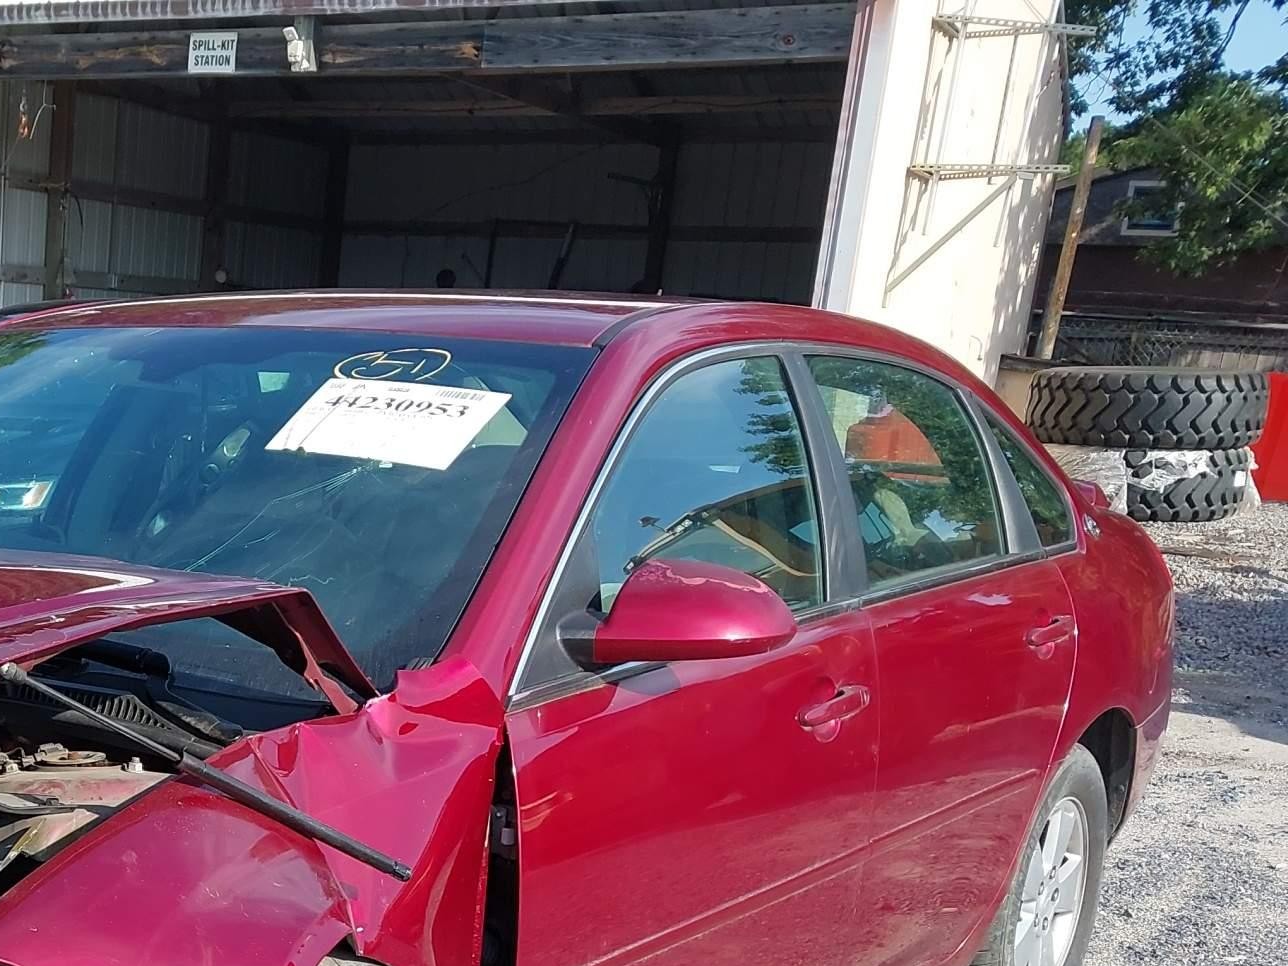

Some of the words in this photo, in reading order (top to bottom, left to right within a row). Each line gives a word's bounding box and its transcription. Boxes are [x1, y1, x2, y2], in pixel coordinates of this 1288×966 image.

[192, 39, 236, 51] SPILL-KIT
[193, 54, 231, 67] STATION
[325, 393, 470, 418] 44230953
